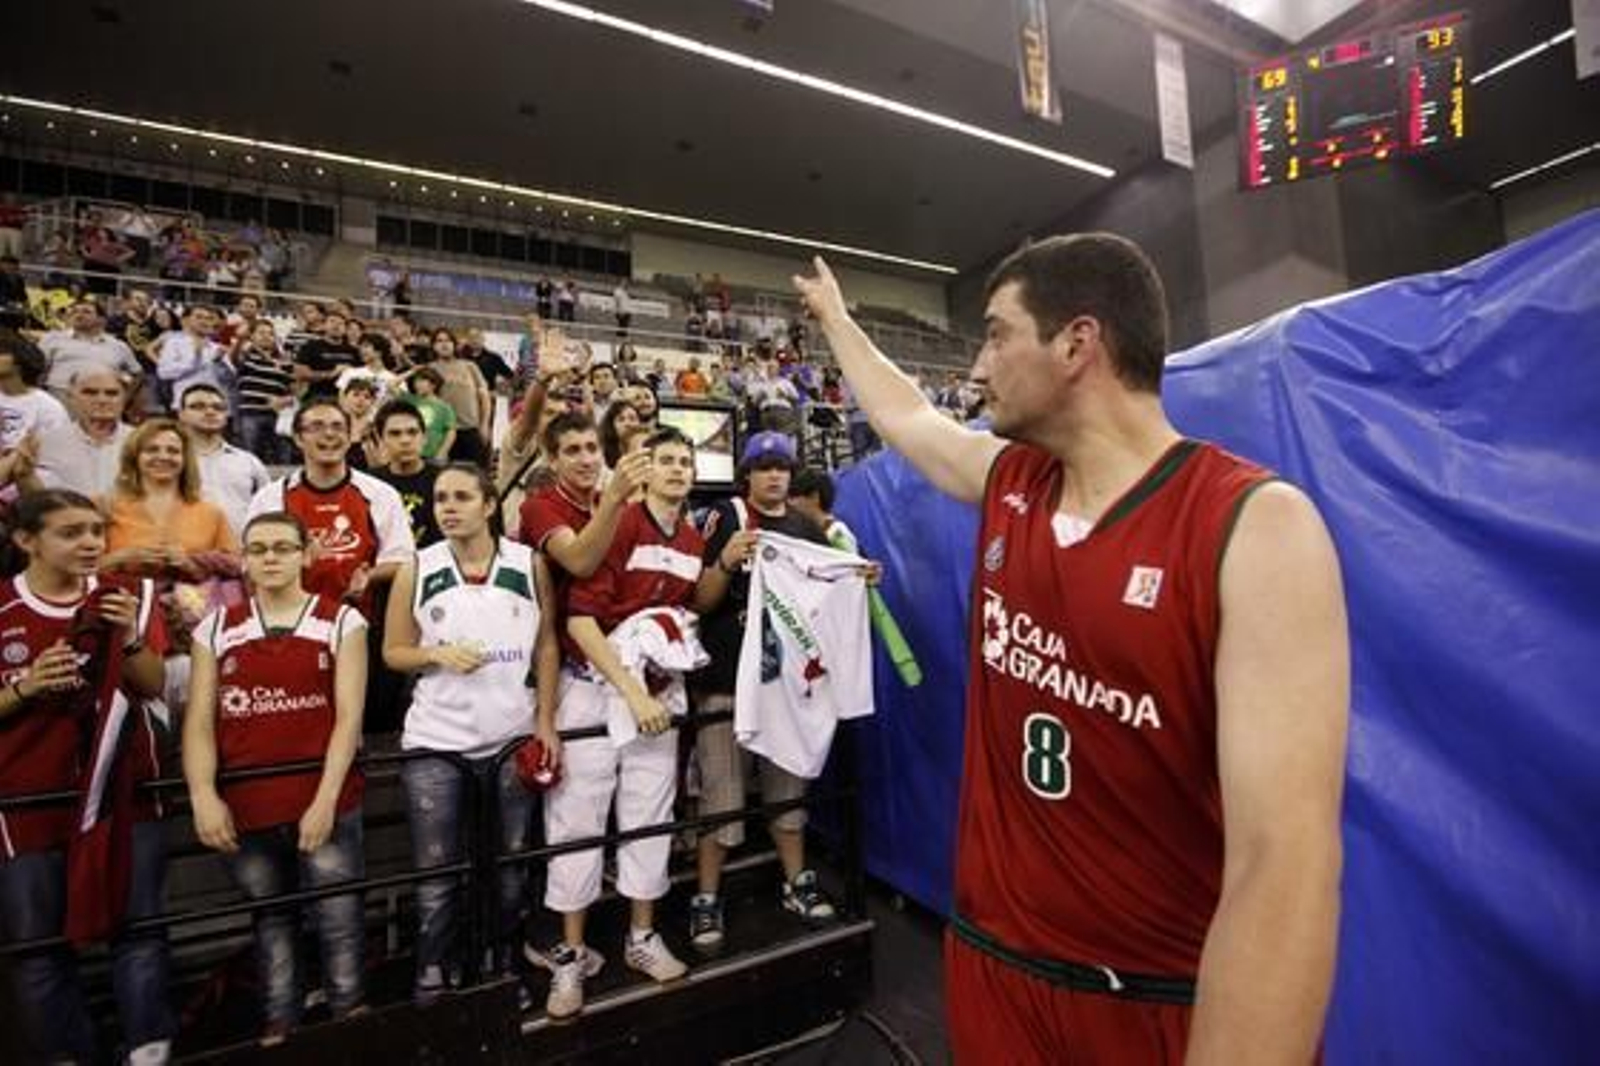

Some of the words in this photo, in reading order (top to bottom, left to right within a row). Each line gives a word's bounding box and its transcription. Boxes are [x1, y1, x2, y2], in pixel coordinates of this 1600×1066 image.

[1427, 27, 1453, 49] 93
[1011, 611, 1067, 661] CAJA
[1008, 646, 1161, 729] GRANADA
[1022, 712, 1071, 800] 8
